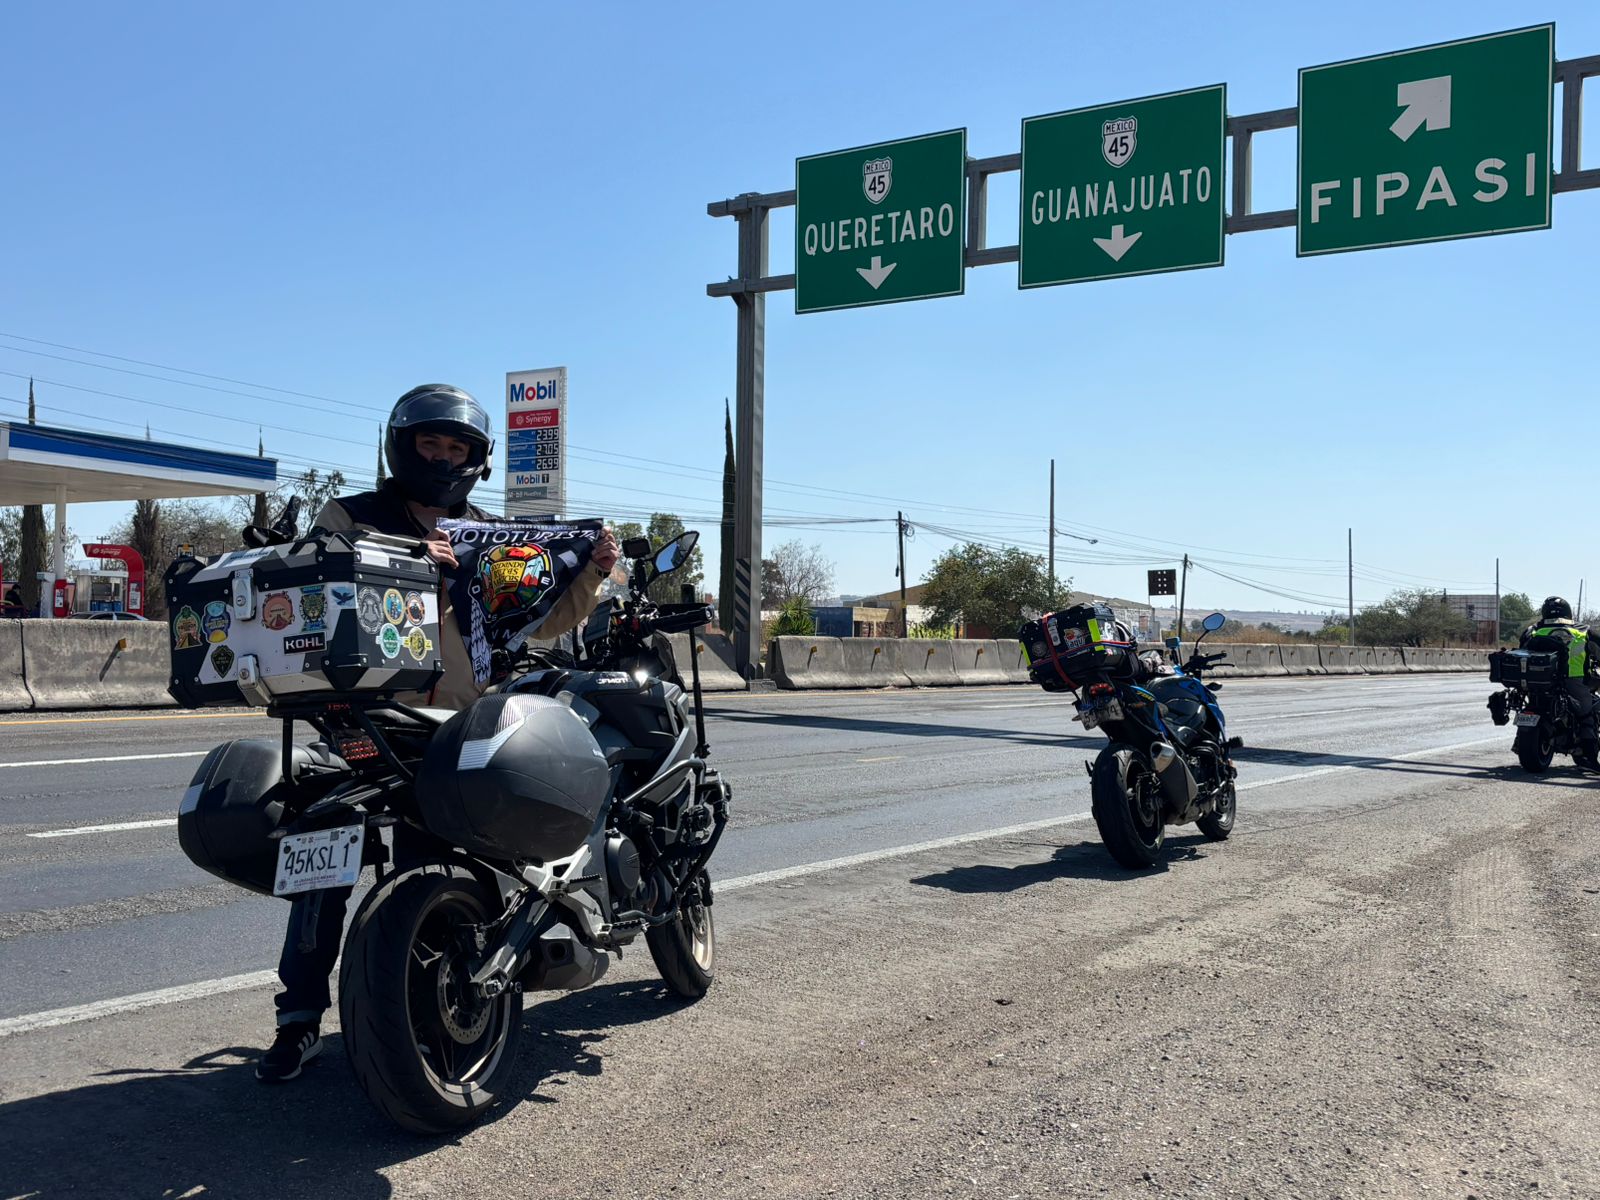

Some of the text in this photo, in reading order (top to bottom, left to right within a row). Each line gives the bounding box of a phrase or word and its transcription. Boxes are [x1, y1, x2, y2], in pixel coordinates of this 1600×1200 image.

[1105, 121, 1134, 133] MEXICO
[1108, 136, 1129, 157] 45
[865, 161, 890, 173] MEXICO
[868, 175, 885, 194] 45
[1311, 152, 1536, 224] FIPASI
[1031, 166, 1211, 225] GUANAJUATO
[804, 203, 954, 256] QUERETARO
[510, 380, 556, 402] Mobil
[525, 414, 552, 425] Synergy
[516, 474, 540, 485] Mobil
[285, 636, 324, 650] KOHL
[343, 842, 350, 868] 1
